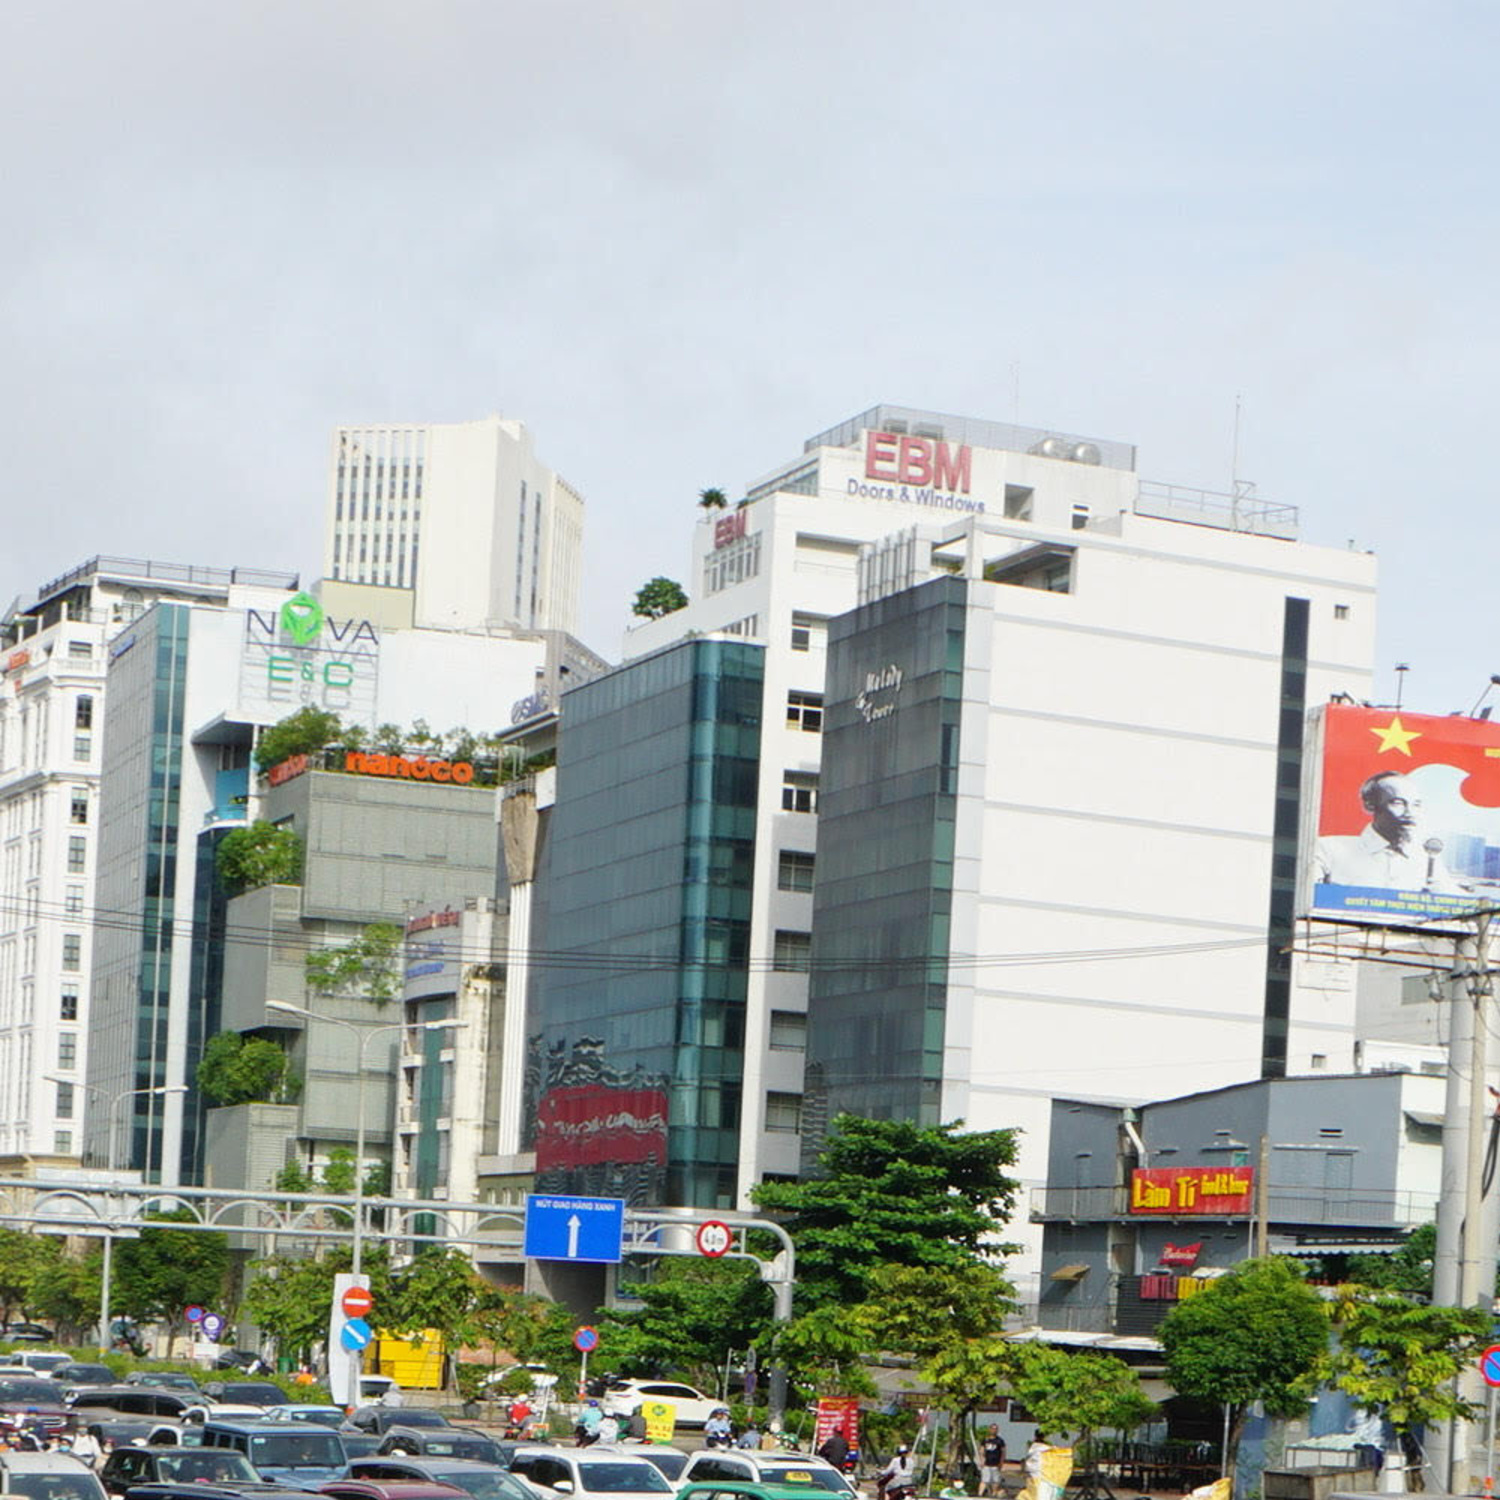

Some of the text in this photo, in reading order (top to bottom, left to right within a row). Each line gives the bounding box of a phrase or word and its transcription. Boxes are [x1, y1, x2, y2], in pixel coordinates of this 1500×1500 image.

[866, 431, 972, 494] EBM
[848, 479, 894, 500] Doors
[900, 487, 911, 503] &
[715, 509, 746, 549] EBM
[866, 664, 902, 693] Melody
[1133, 1176, 1199, 1208] Làm Tí
